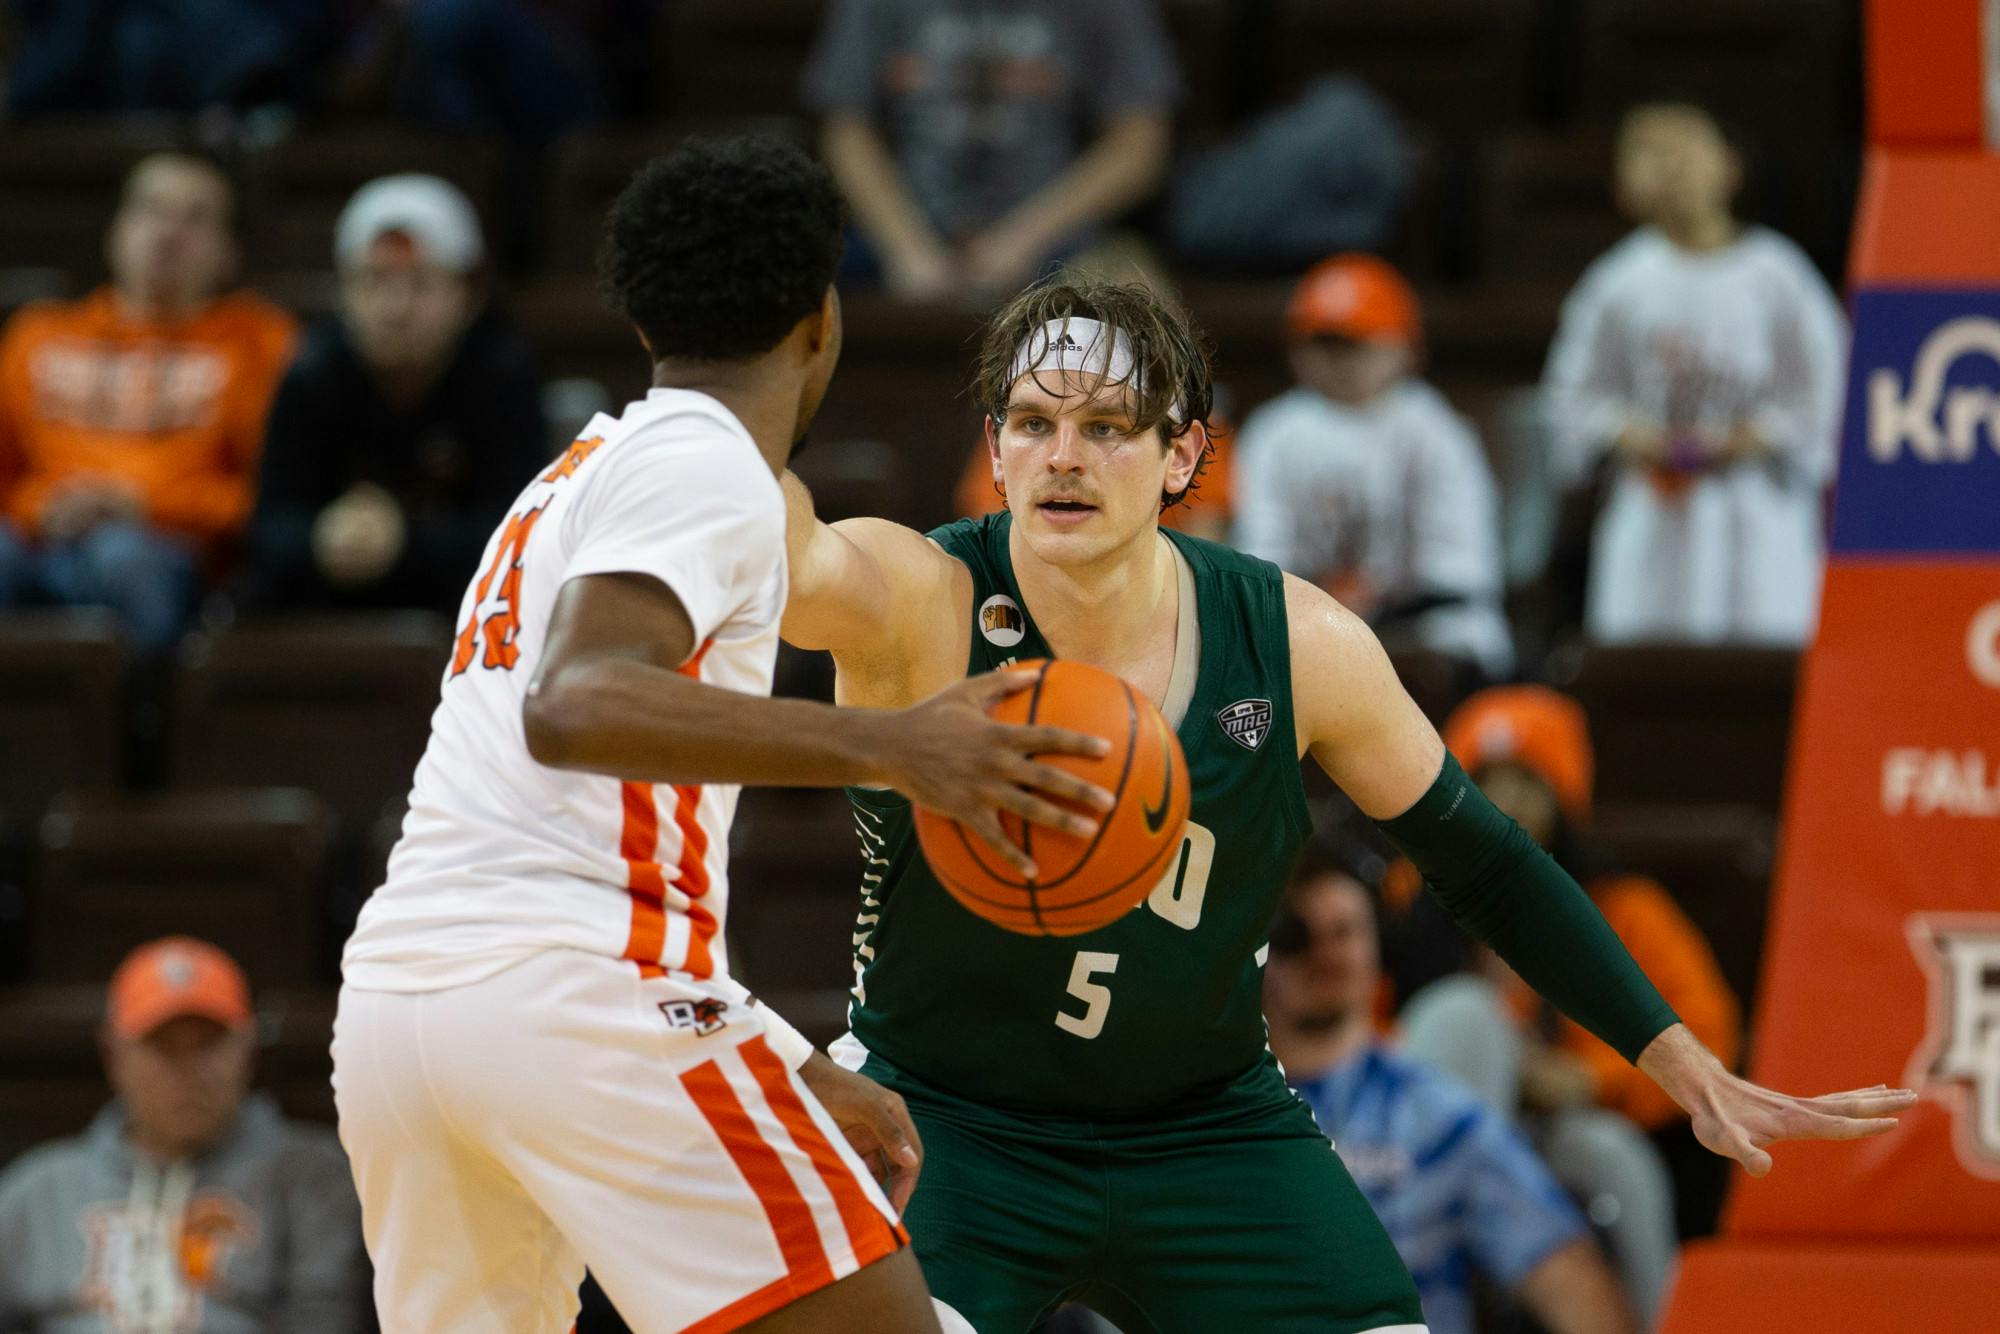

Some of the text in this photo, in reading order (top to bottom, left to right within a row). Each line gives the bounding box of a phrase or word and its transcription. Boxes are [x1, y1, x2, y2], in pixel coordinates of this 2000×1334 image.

[1866, 314, 2000, 464] Kr
[1226, 712, 1271, 733] MAC
[1881, 746, 2000, 817] FAL
[1055, 950, 1120, 1040] 5
